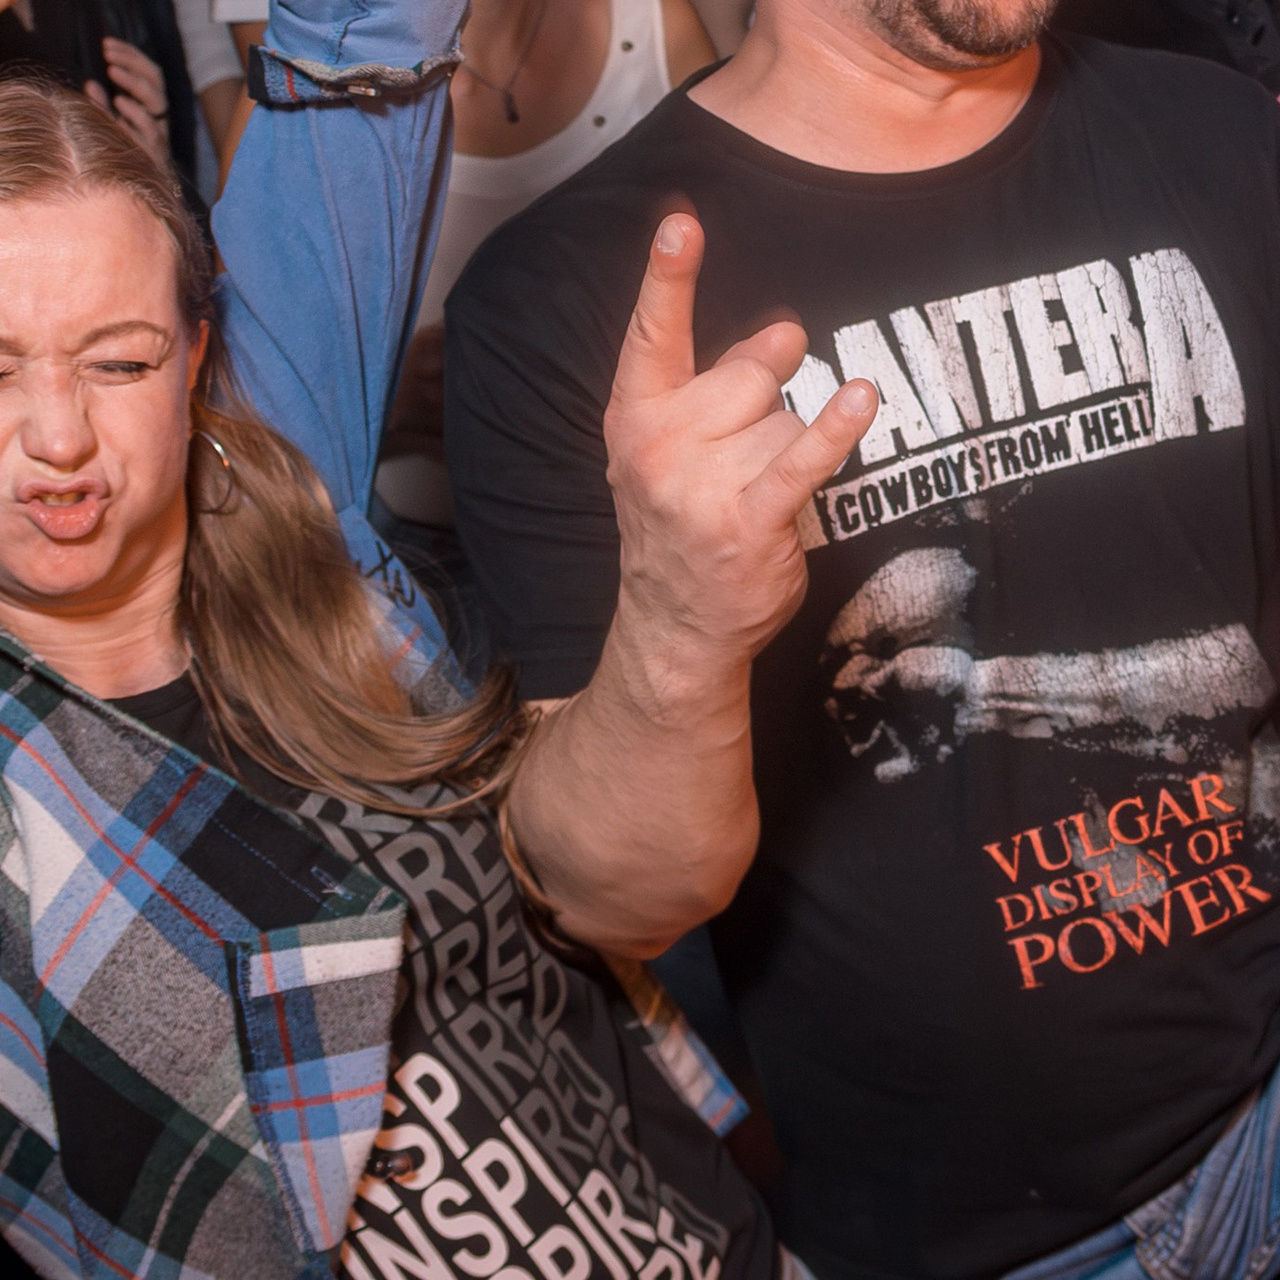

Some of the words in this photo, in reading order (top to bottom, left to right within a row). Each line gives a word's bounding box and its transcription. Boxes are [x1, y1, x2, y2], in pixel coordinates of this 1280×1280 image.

[834, 442, 987, 536] COWBOYS
[985, 420, 1072, 482] FROM
[1080, 397, 1155, 451] HELL
[982, 773, 1237, 884] VULGAR
[995, 843, 1181, 933] DISPLAY
[1187, 820, 1244, 866] OF
[1007, 863, 1273, 991] POWER
